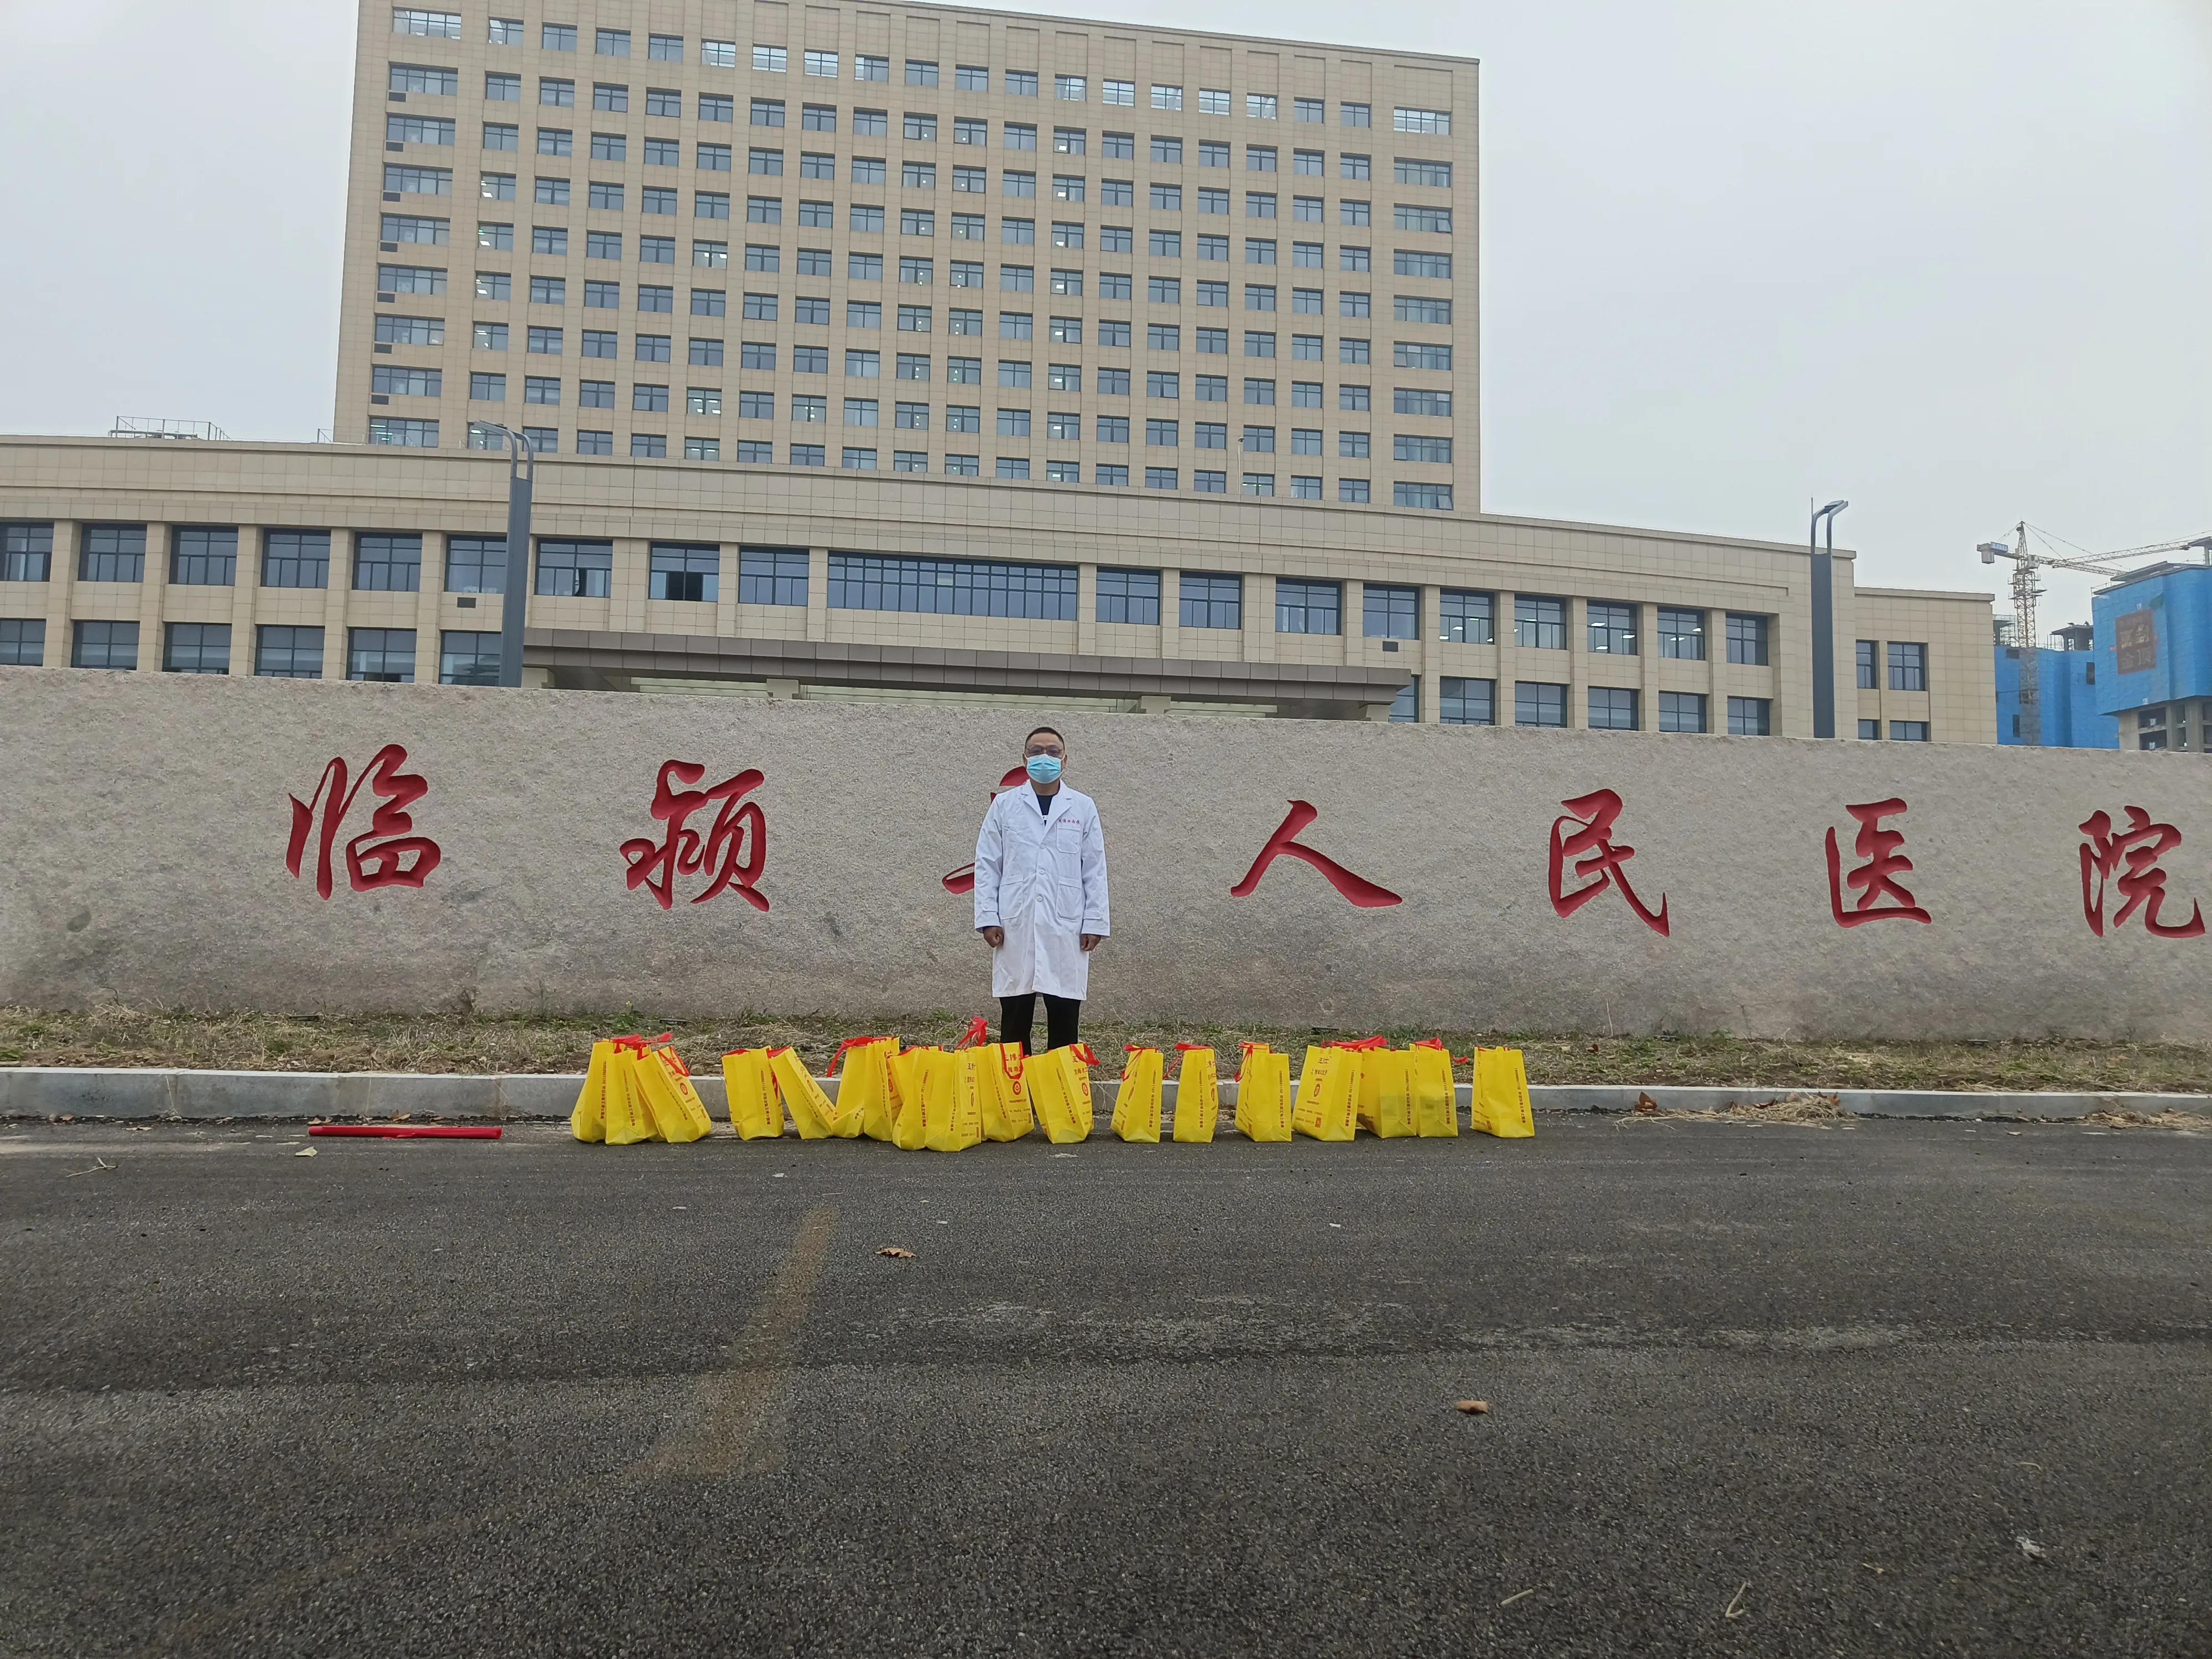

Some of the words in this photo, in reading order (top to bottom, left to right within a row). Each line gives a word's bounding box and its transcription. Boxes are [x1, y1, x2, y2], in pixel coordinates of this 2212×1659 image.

[286, 744, 2205, 938] 临颍人民医院
